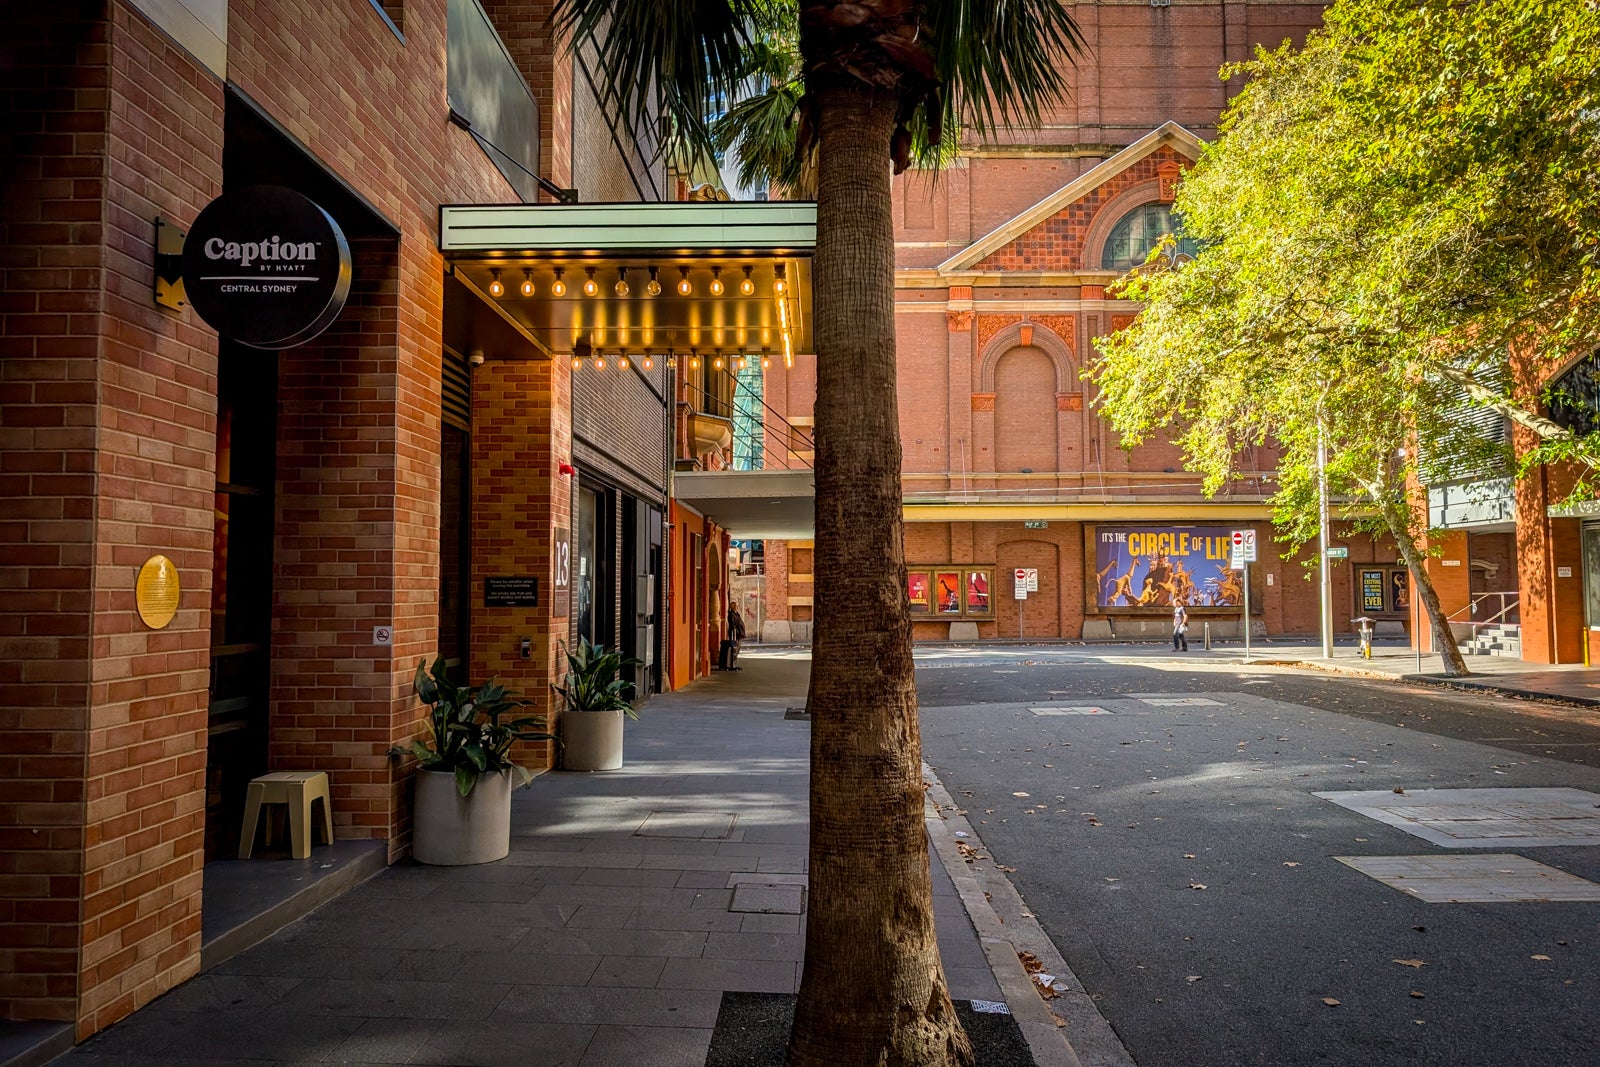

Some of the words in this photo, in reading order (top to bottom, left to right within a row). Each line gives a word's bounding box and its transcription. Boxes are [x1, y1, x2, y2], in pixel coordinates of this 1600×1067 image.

[204, 235, 317, 266] Caption
[1102, 533, 1113, 543] IT'S
[1115, 533, 1126, 543] THE
[1128, 532, 1189, 556] CIRCLE
[1192, 536, 1203, 551] OF
[1205, 537, 1231, 560] LIF
[556, 541, 569, 586] 13
[1364, 597, 1382, 606] EVER
